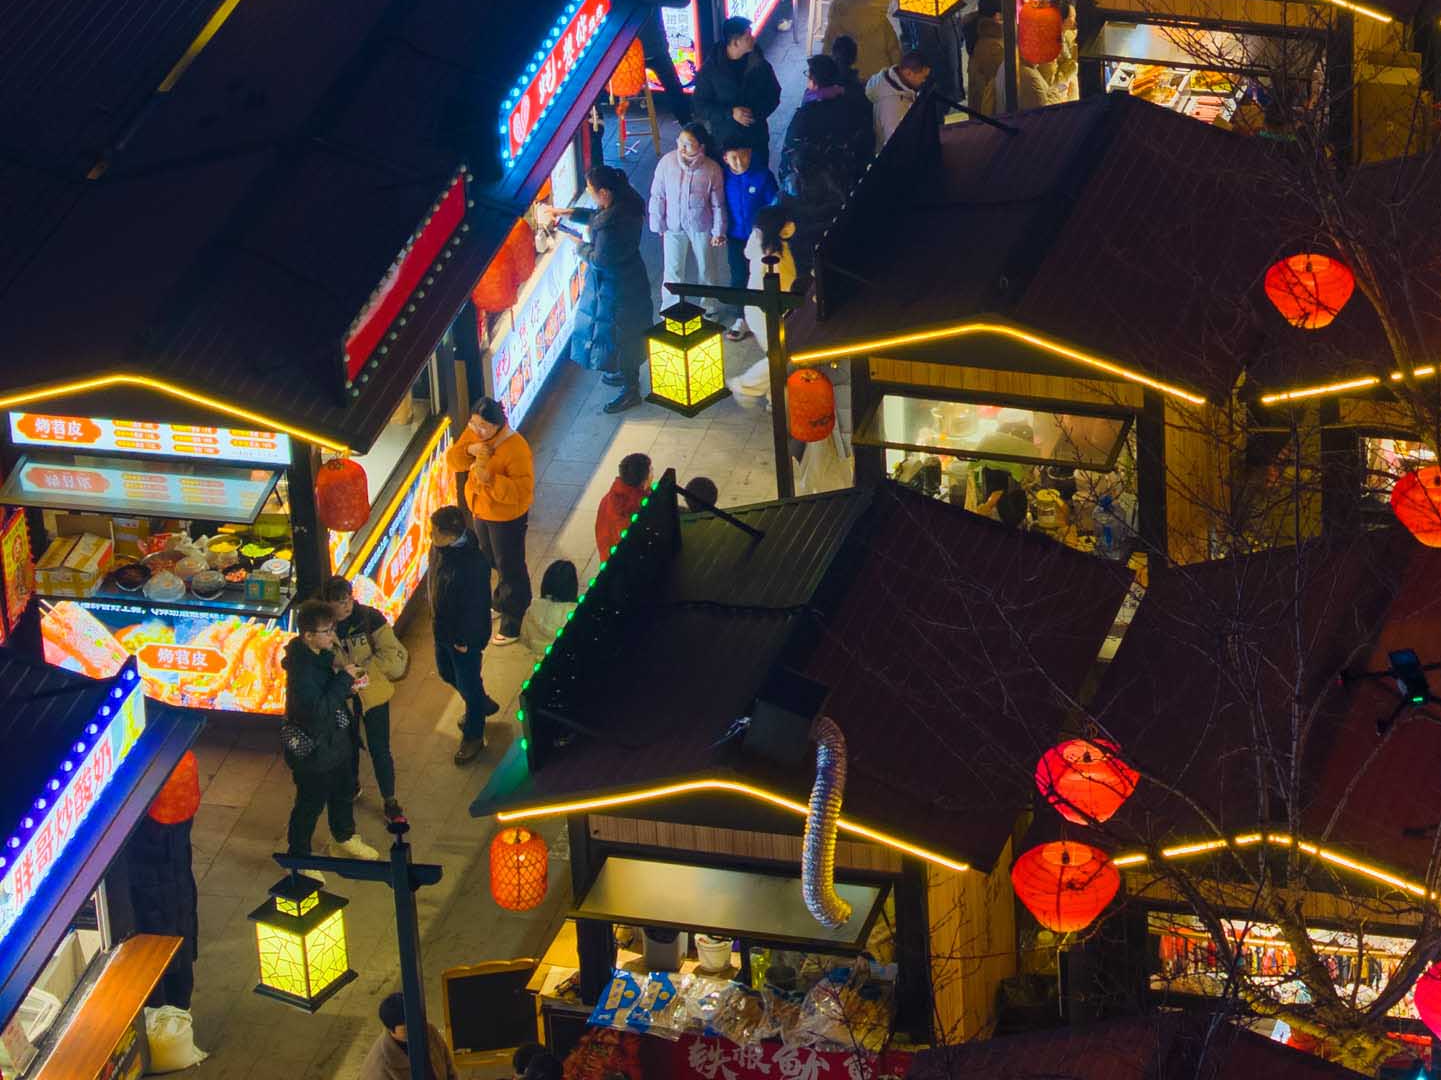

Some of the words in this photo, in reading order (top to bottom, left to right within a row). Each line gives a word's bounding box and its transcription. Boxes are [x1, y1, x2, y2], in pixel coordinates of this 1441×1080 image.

[34, 416, 85, 437] 烤苕皮
[156, 647, 209, 667] 烤苕皮
[13, 738, 113, 909] 胖哥炒酸奶
